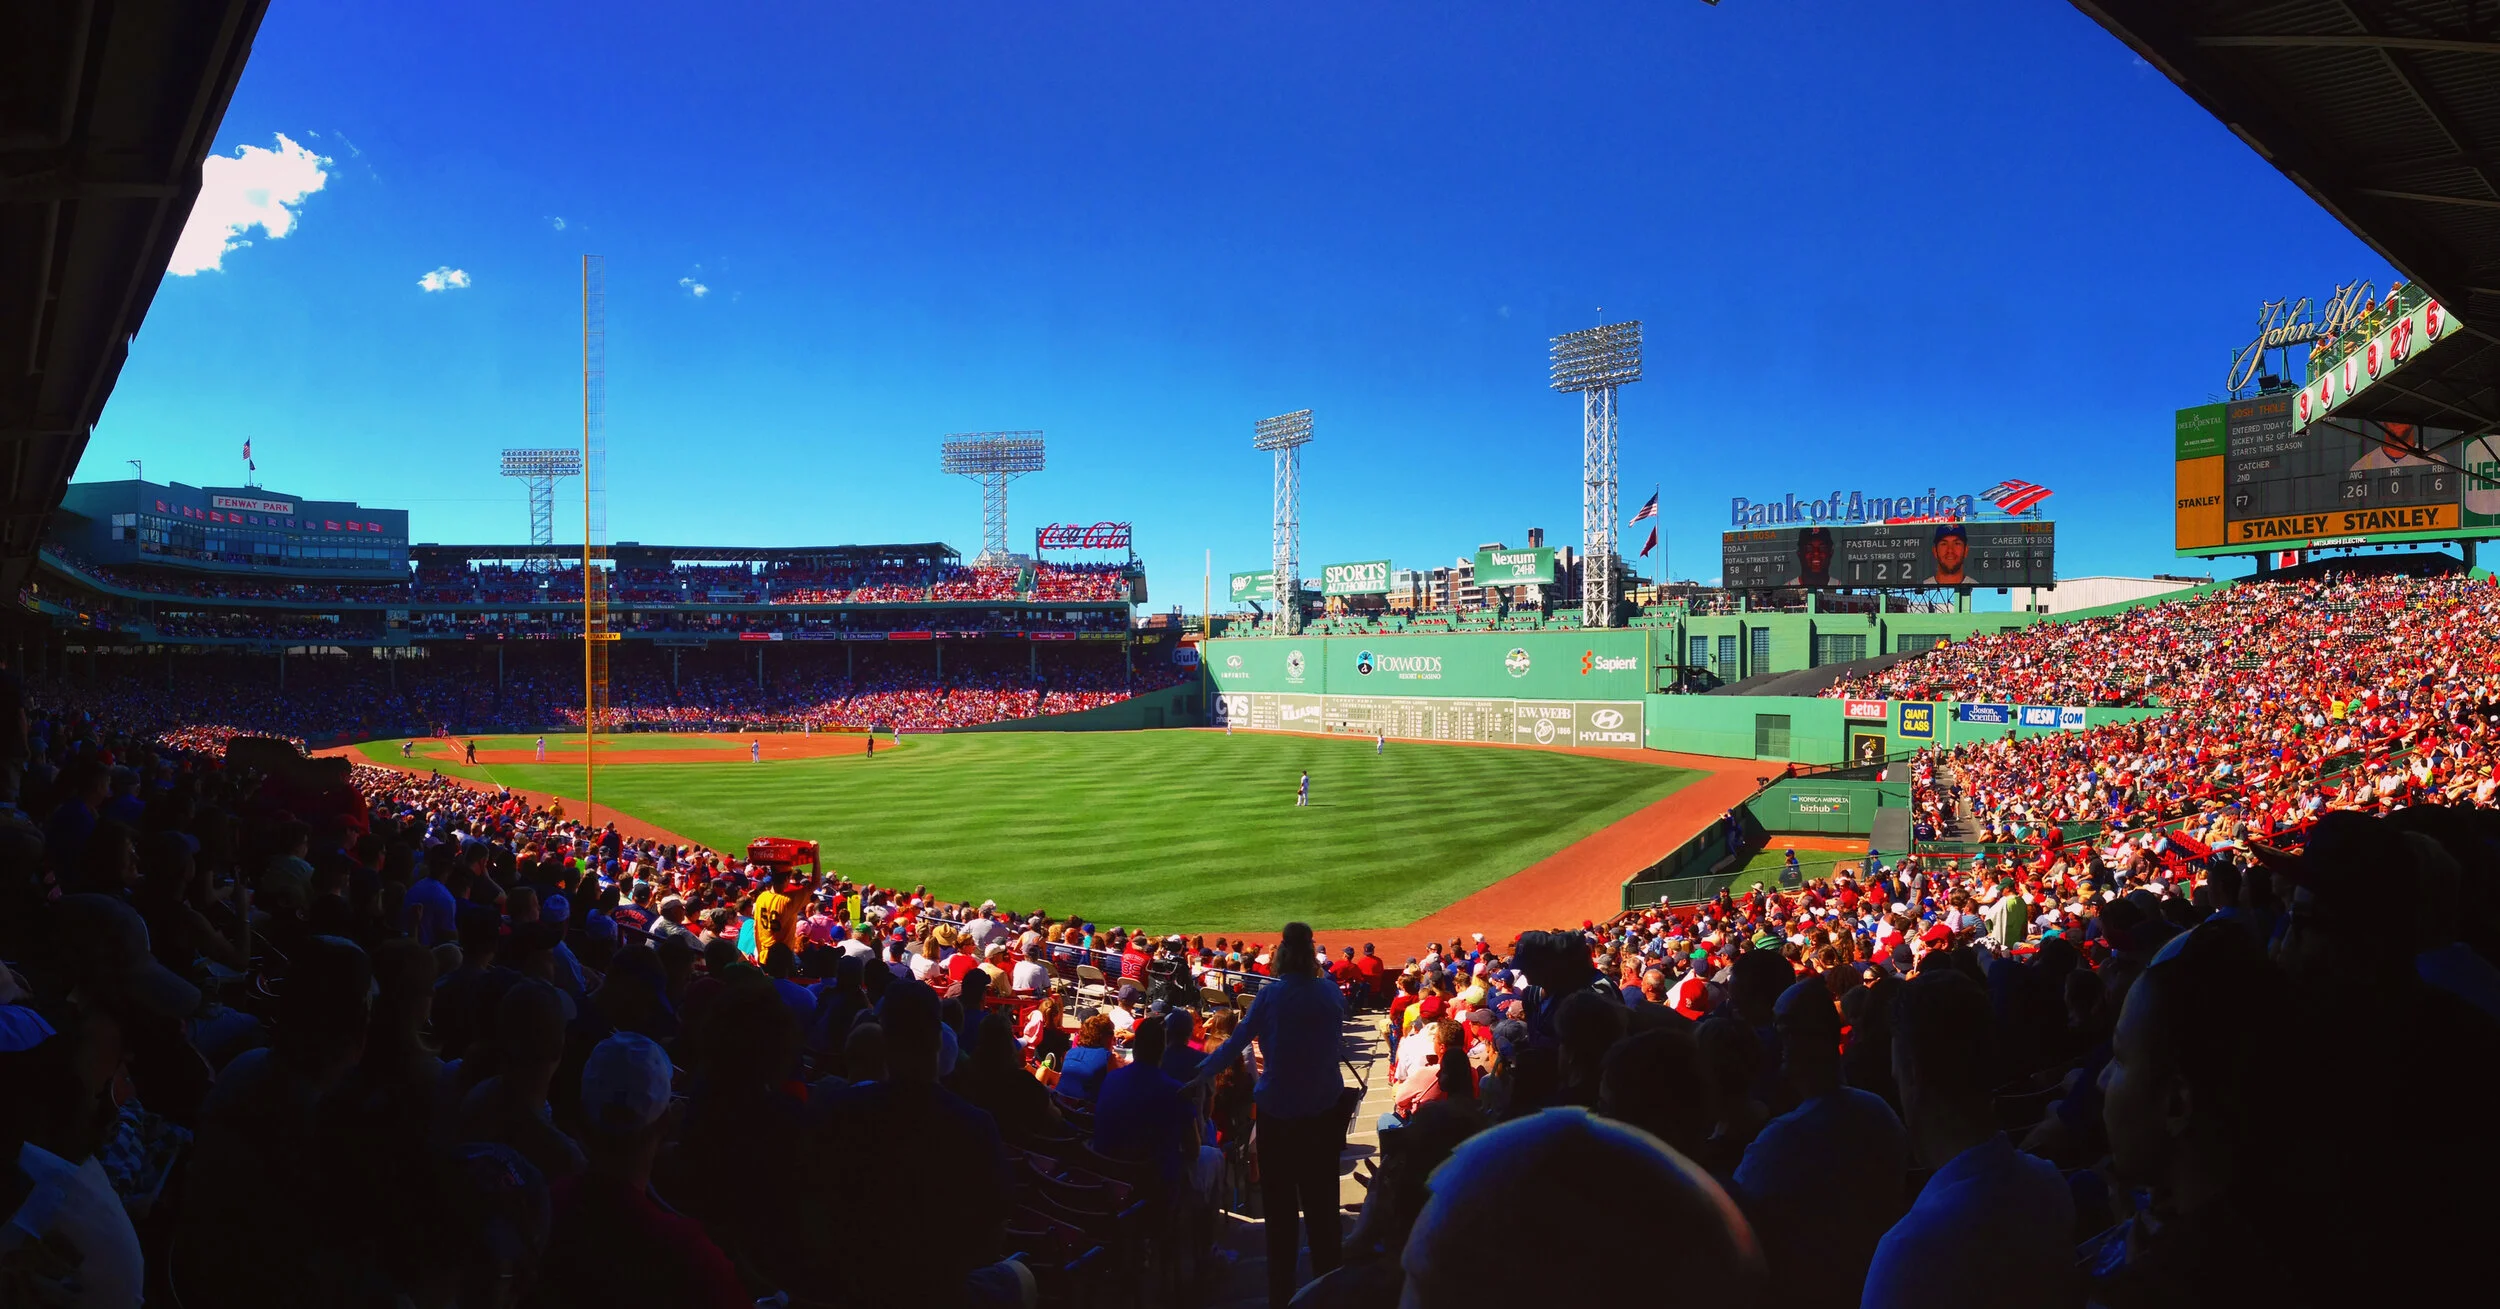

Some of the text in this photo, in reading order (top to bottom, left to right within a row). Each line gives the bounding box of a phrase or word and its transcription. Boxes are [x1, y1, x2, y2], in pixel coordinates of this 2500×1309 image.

[2227, 297, 2313, 392] John
[2390, 317, 2410, 360] 27
[2232, 402, 2286, 418] JOSH THOLE
[2232, 424, 2260, 435] ENTERED
[2263, 421, 2284, 430] TODAY
[2232, 436, 2254, 446] DICKEY
[2232, 442, 2302, 456] STARTS THIS SEASON
[2238, 460, 2270, 470] CATCHER
[2236, 474, 2250, 482] 2ND
[2350, 471, 2362, 480] AVG
[2342, 484, 2368, 498] .261
[2434, 478, 2442, 491] 6
[218, 498, 288, 512] FENWAY PARK
[1732, 488, 1976, 526] Bank of America
[2178, 496, 2220, 508] STANLEY
[2236, 496, 2248, 506] F7
[2344, 508, 2439, 530] STANLEY
[2021, 524, 2052, 532] THOLE
[2243, 516, 2328, 539] STANLEY
[1039, 522, 1132, 550] Coca-Cola
[1724, 532, 1776, 542] DE LA ROSA
[1846, 540, 1887, 548] FASTBALL
[1492, 553, 1535, 566] Nexium
[1983, 560, 1988, 568] 6
[1326, 563, 1386, 582] SPORTS
[1877, 564, 1886, 580] 2
[1902, 563, 1912, 579] 2
[1327, 580, 1386, 593] AUTHORITY
[1176, 650, 1199, 660] Gulf
[1377, 655, 1442, 672] FOXWOODS
[1595, 656, 1636, 672] Sapient
[1216, 695, 1248, 716] CVS
[1850, 702, 1880, 716] aetna
[1973, 705, 1994, 714] Boston
[1540, 708, 1571, 719] WEBB
[1904, 709, 1928, 720] GIANT
[1968, 710, 2002, 722] Scientific
[2026, 708, 2056, 724] NESN
[1518, 726, 1532, 734] Since
[1904, 720, 1930, 732] GLASS
[1580, 732, 1636, 742] HYUNDAI
[1800, 804, 1830, 812] bizhub
